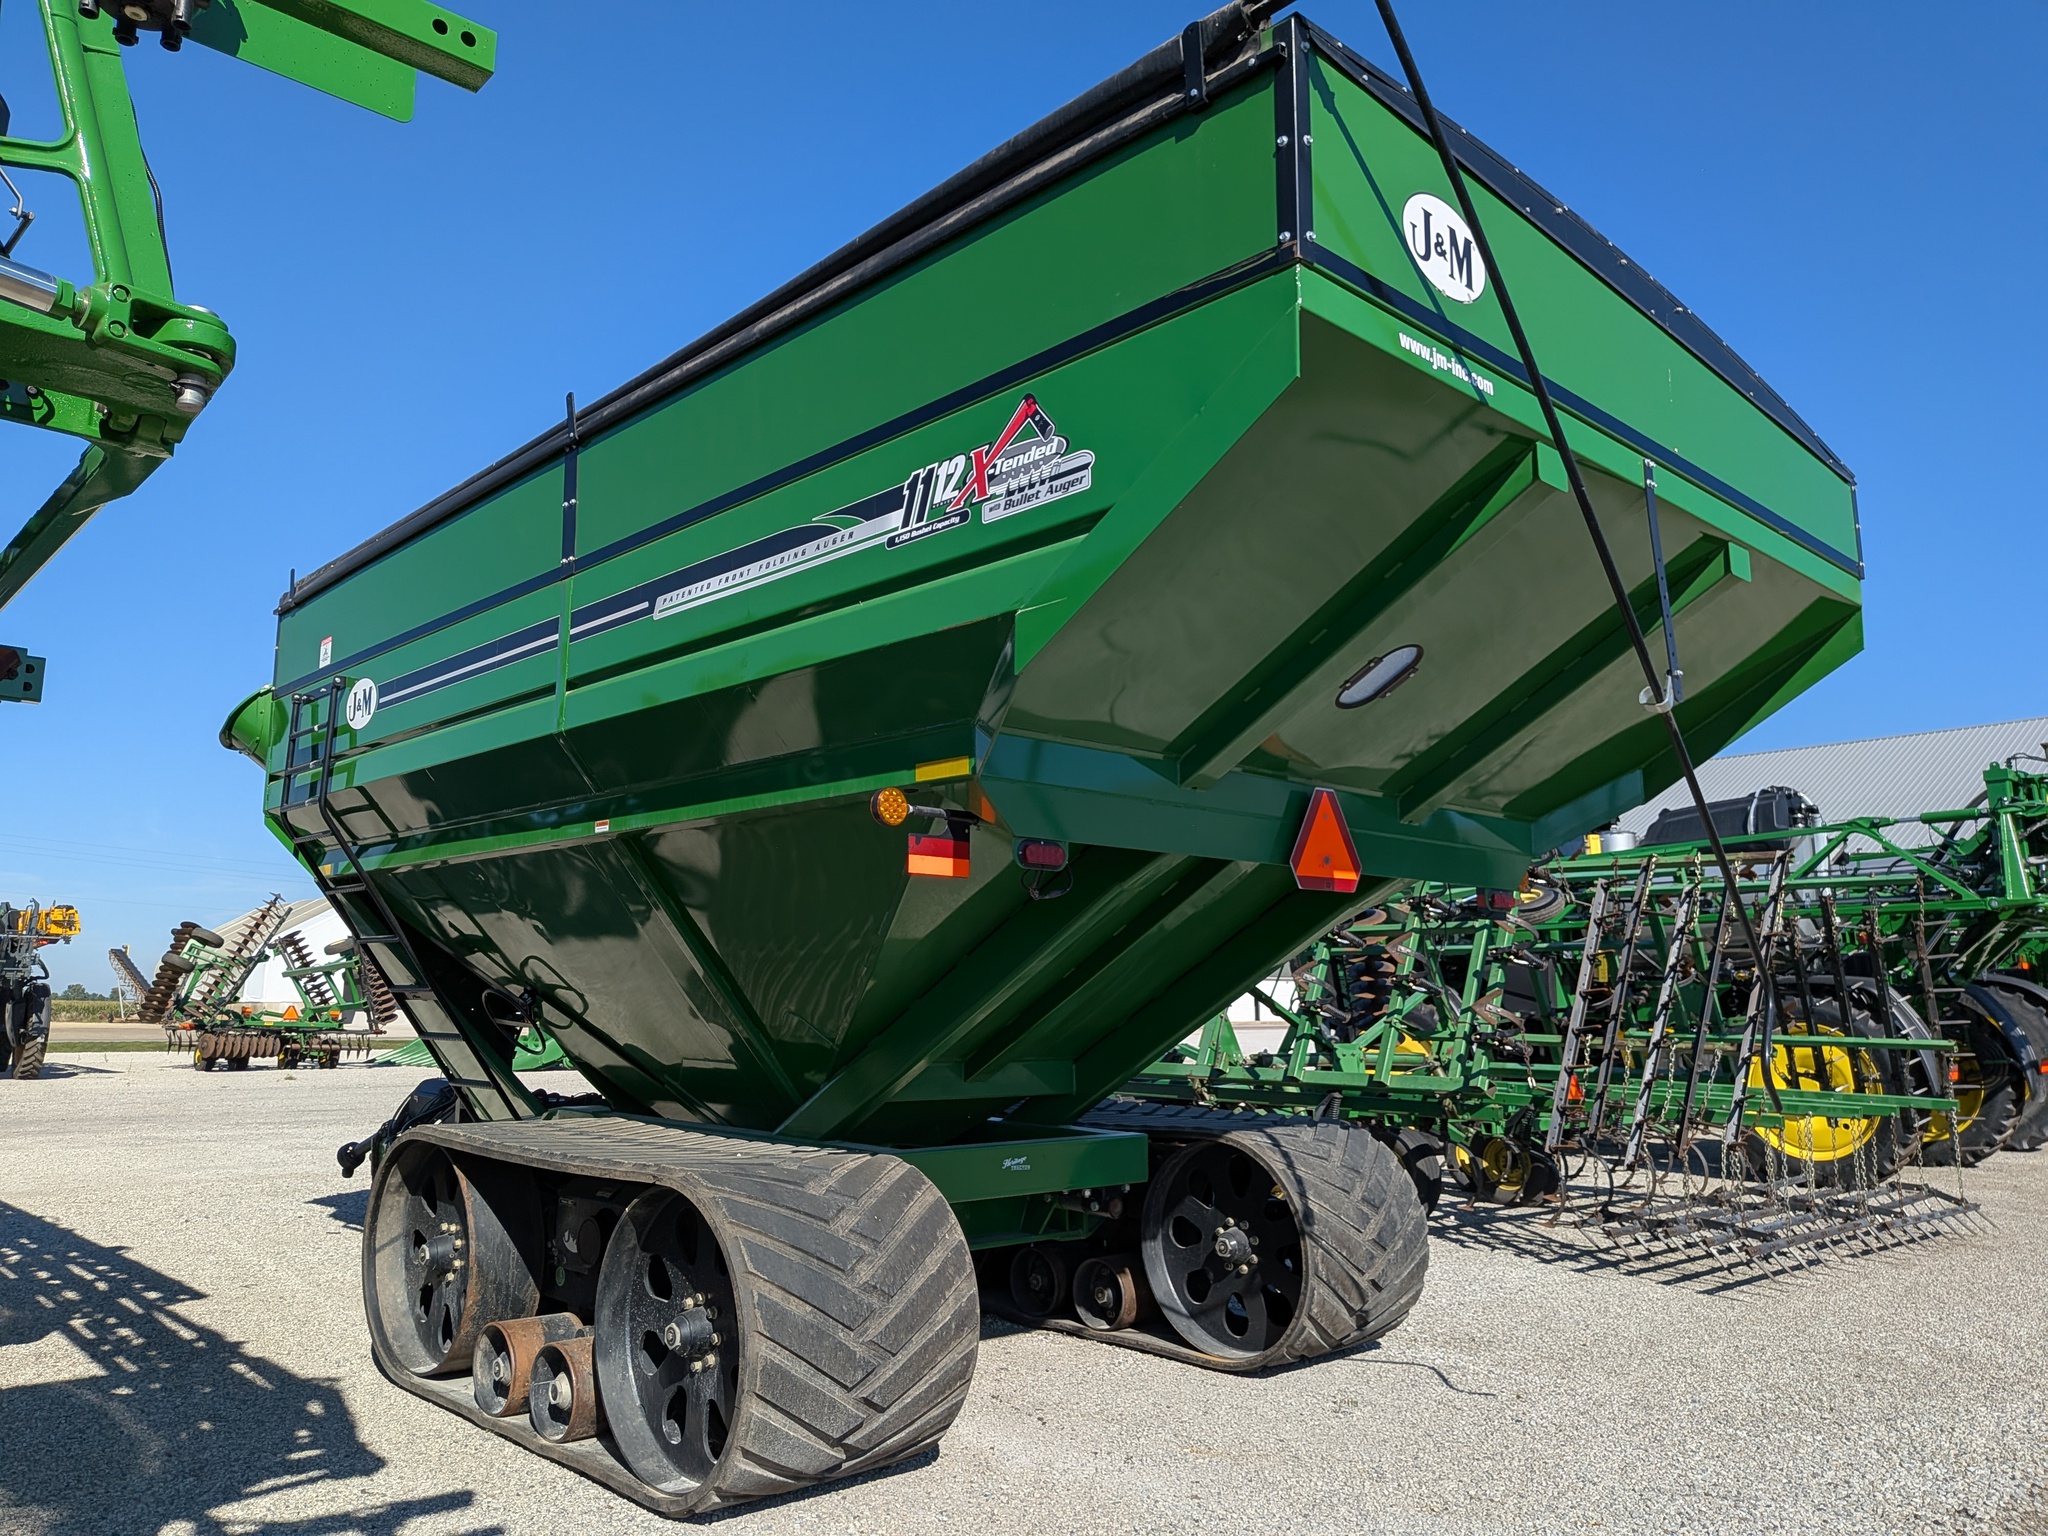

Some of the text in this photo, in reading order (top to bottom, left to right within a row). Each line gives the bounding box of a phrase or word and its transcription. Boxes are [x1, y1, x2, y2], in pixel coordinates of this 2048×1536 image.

[1409, 207, 1474, 292] J&M
[1399, 332, 1494, 396] www.jm-inc.com
[899, 454, 966, 530] 1112
[933, 515, 960, 530] Capacity
[1003, 489, 1040, 511] Bullet
[1046, 475, 1086, 498] Auger
[661, 531, 854, 605] PATENTED FRONT FOLDING AUGER
[348, 686, 373, 722] J&M
